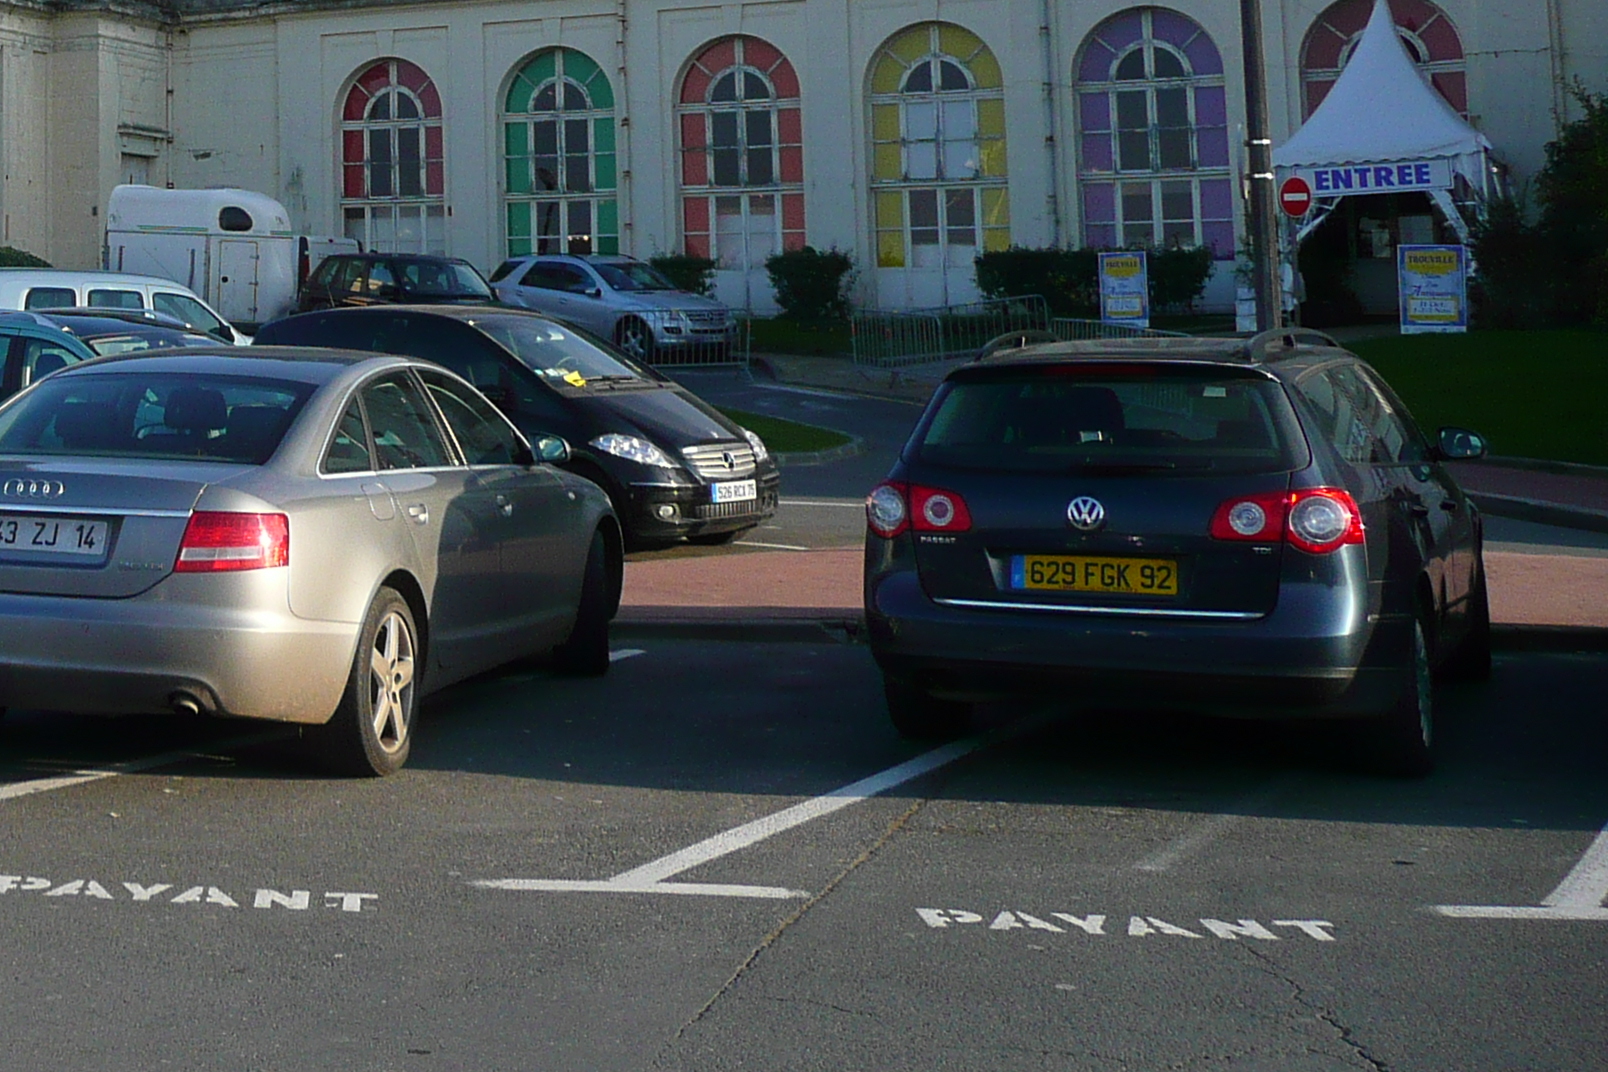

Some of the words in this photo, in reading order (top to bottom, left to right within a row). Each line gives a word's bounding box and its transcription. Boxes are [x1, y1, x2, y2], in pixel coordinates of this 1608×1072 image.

[1313, 163, 1432, 191] ENTREE
[717, 485, 733, 499] 526
[32, 522, 60, 547] ZJ
[75, 524, 96, 549] 14
[920, 535, 957, 545] PASSAT
[1030, 560, 1076, 586] 629
[1083, 562, 1134, 589] FGK
[1139, 565, 1172, 591] 92
[914, 907, 1336, 942] PAYANT
